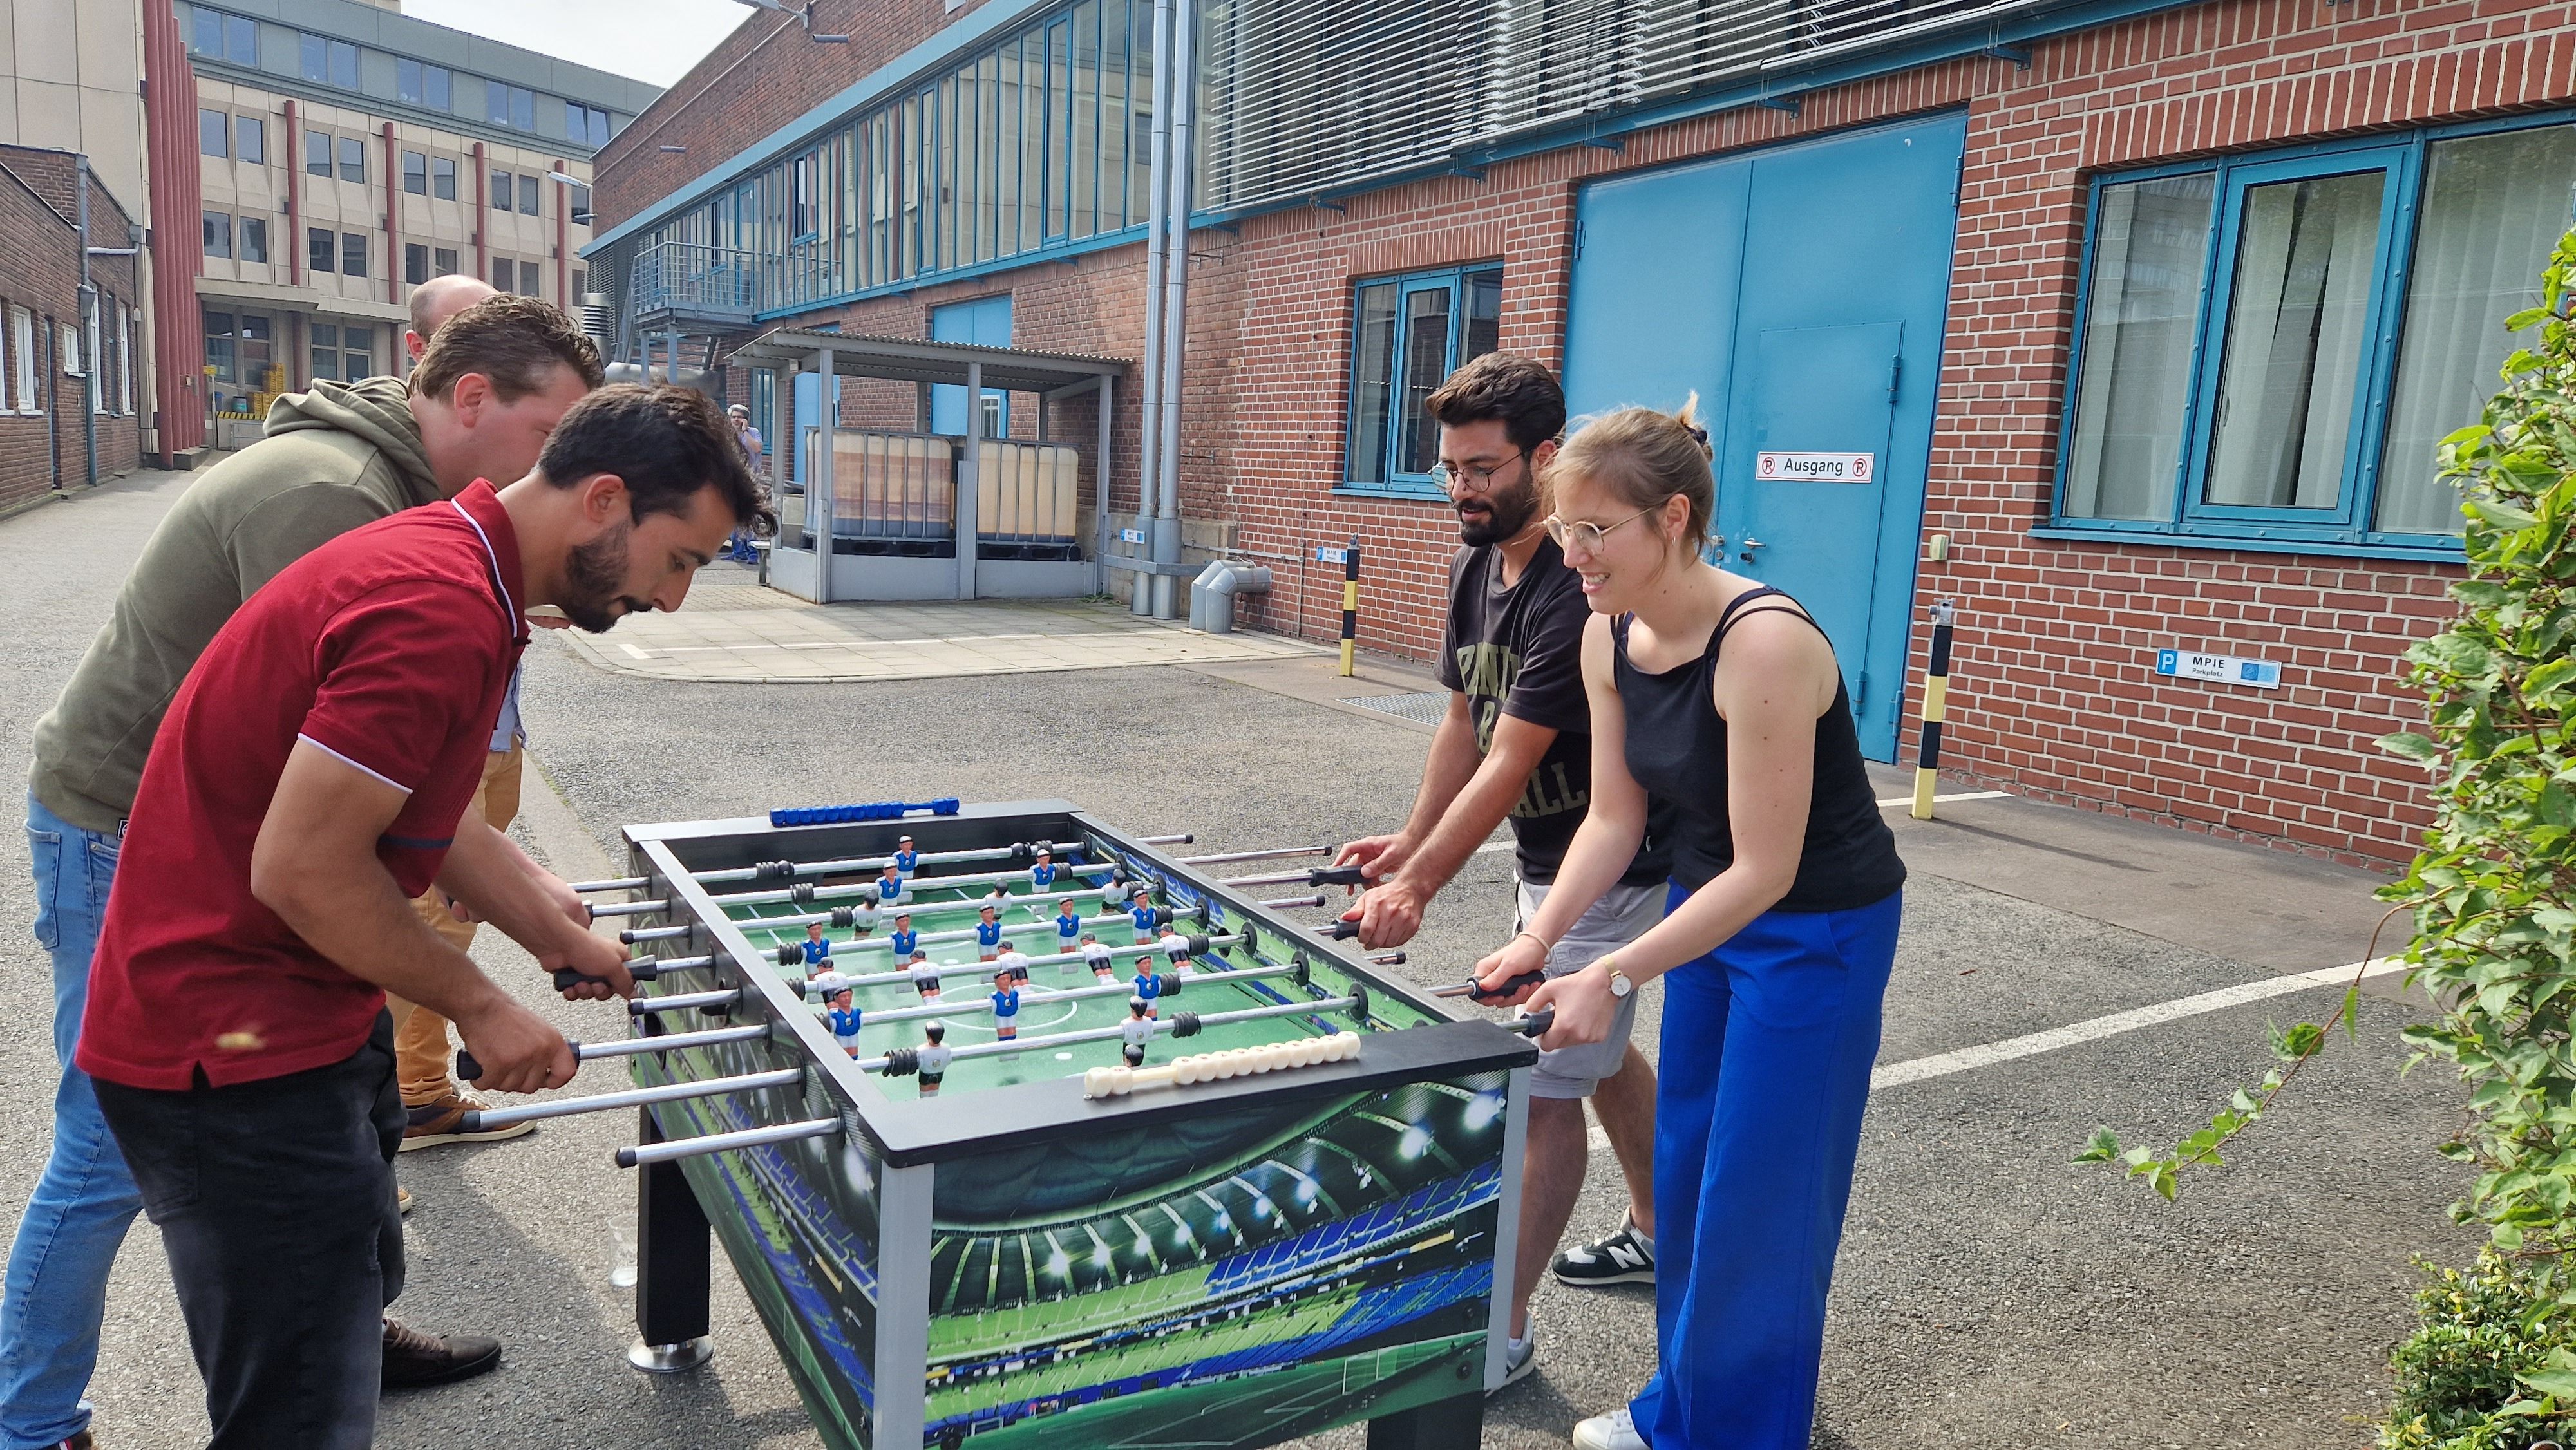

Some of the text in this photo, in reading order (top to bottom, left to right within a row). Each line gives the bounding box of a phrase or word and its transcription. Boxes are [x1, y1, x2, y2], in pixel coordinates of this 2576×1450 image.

[1784, 458, 1844, 476] Ausgang
[2161, 653, 2175, 670] P
[2192, 656, 2226, 668] MPIE
[2192, 668, 2223, 677] Parkplatz
[1607, 1243, 1646, 1269] N
